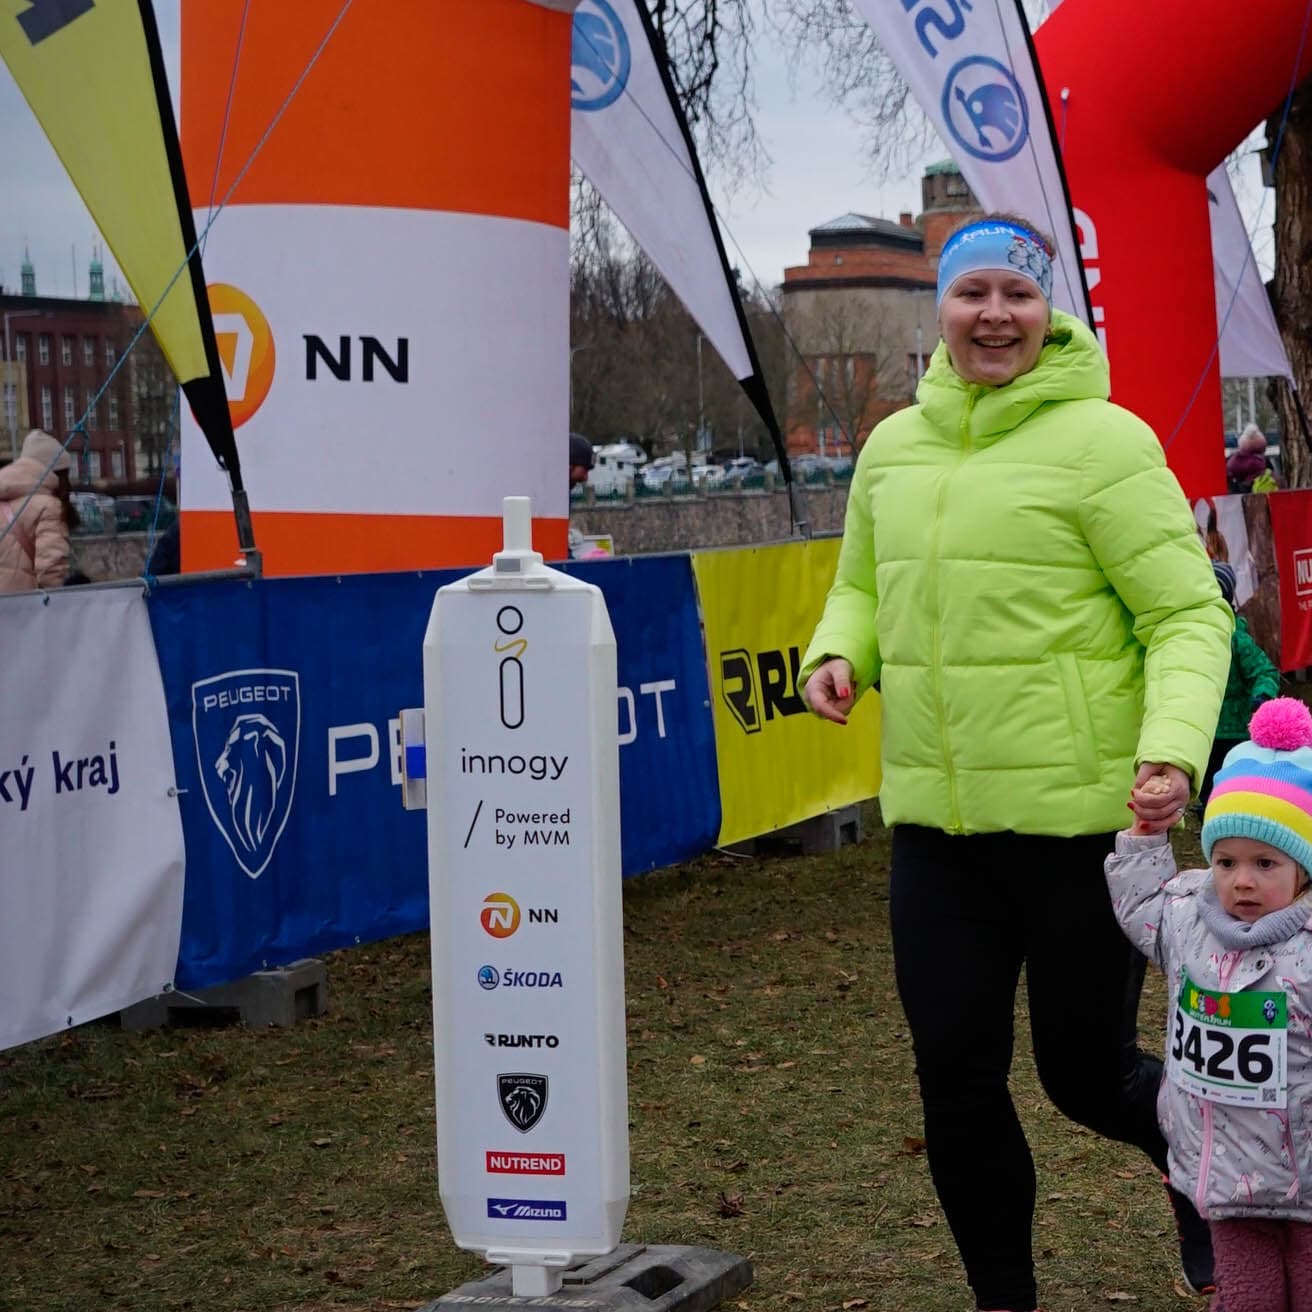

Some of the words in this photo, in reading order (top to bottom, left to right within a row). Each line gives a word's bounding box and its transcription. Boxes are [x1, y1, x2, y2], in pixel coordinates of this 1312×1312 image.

[302, 334, 409, 384] NN
[203, 686, 291, 712] PEUGEOT
[52, 741, 120, 794] kraj
[461, 747, 569, 781] innogy
[495, 807, 571, 824] Powered
[495, 829, 516, 849] by
[523, 830, 570, 845] MVM
[528, 908, 559, 923] NN
[502, 968, 563, 987] ŠKODA
[498, 1034, 560, 1048] RUNTO
[1172, 1010, 1273, 1083] 3426
[490, 1156, 561, 1171] NUTREND
